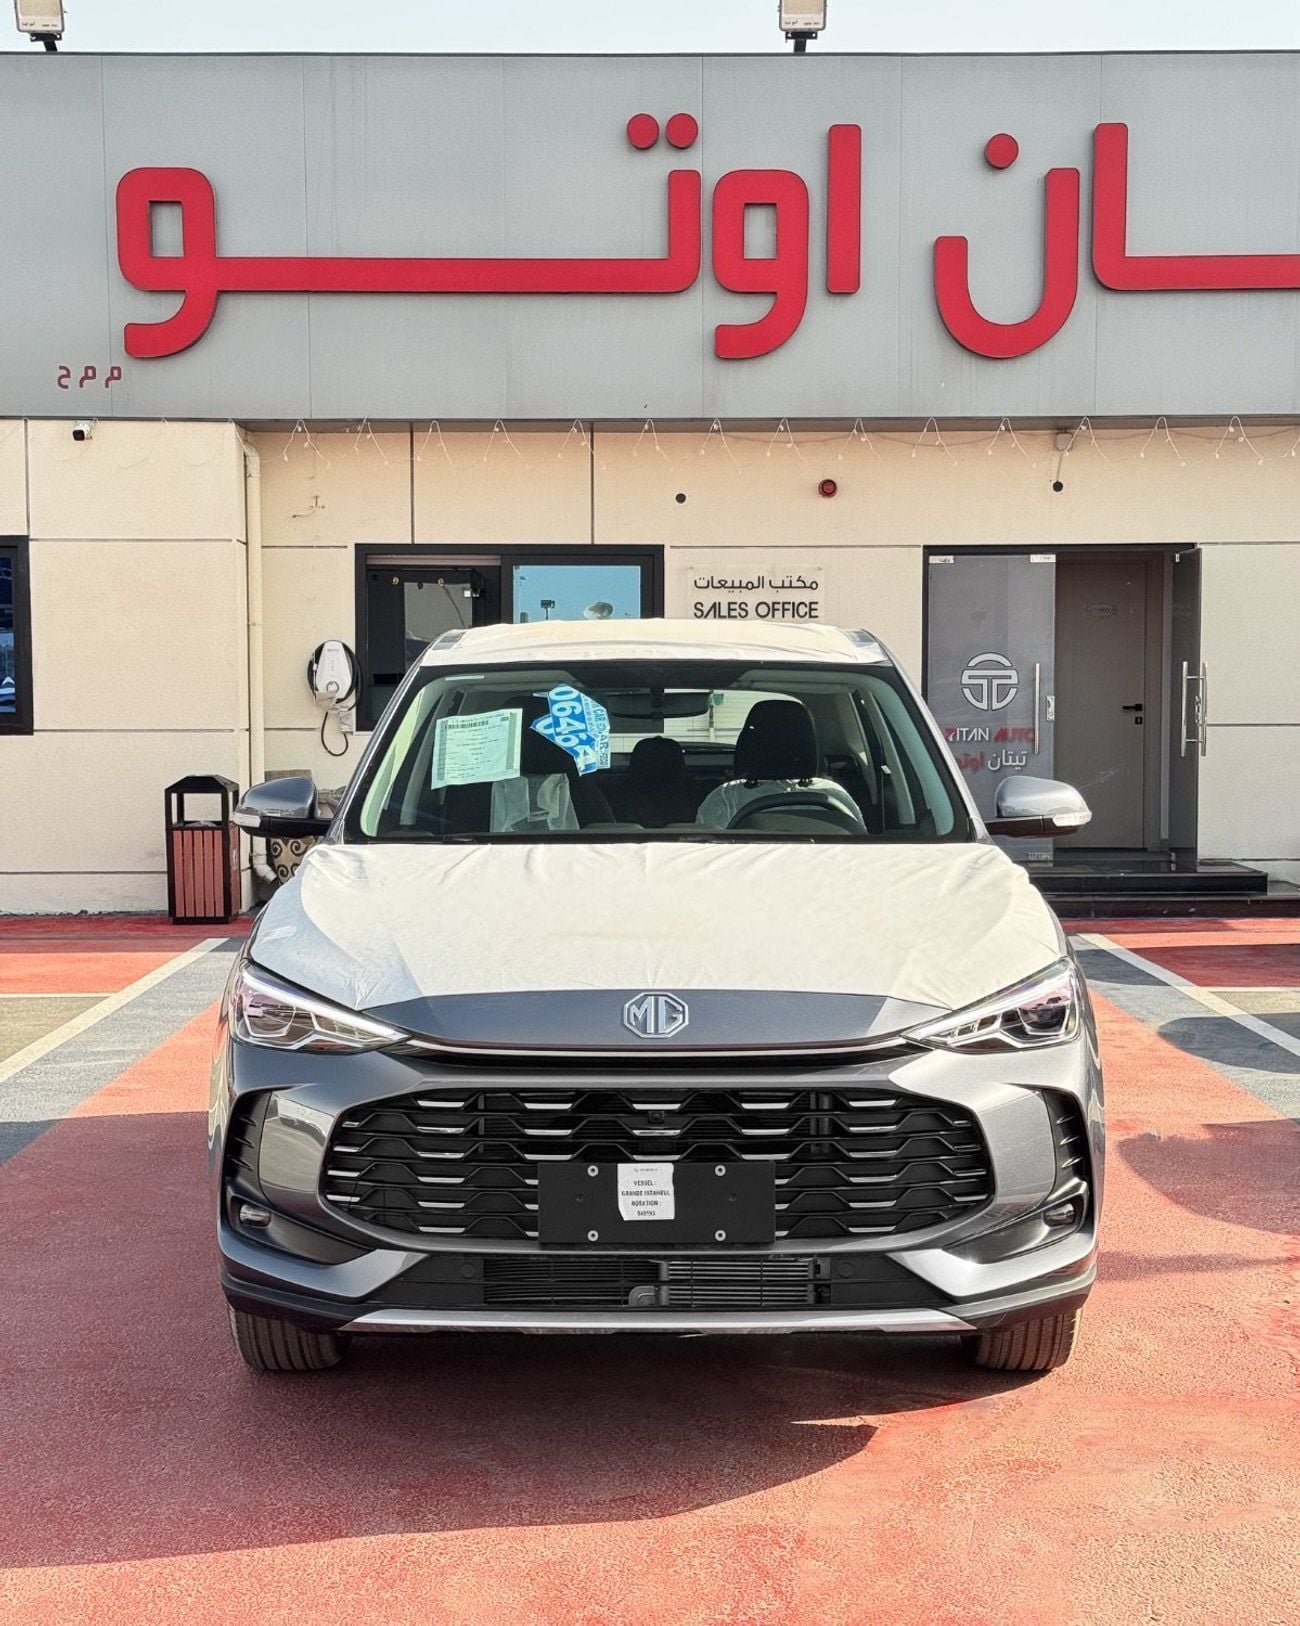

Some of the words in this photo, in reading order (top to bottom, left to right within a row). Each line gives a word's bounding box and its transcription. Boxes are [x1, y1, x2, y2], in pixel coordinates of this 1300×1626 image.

[116, 113, 861, 360] اوتو
[694, 575, 764, 594] المبيعات
[769, 575, 819, 594] مكتب
[693, 601, 749, 619] SALES
[755, 601, 819, 619] OFFICE
[987, 748, 1028, 771] تيتان
[629, 995, 684, 1034] MG
